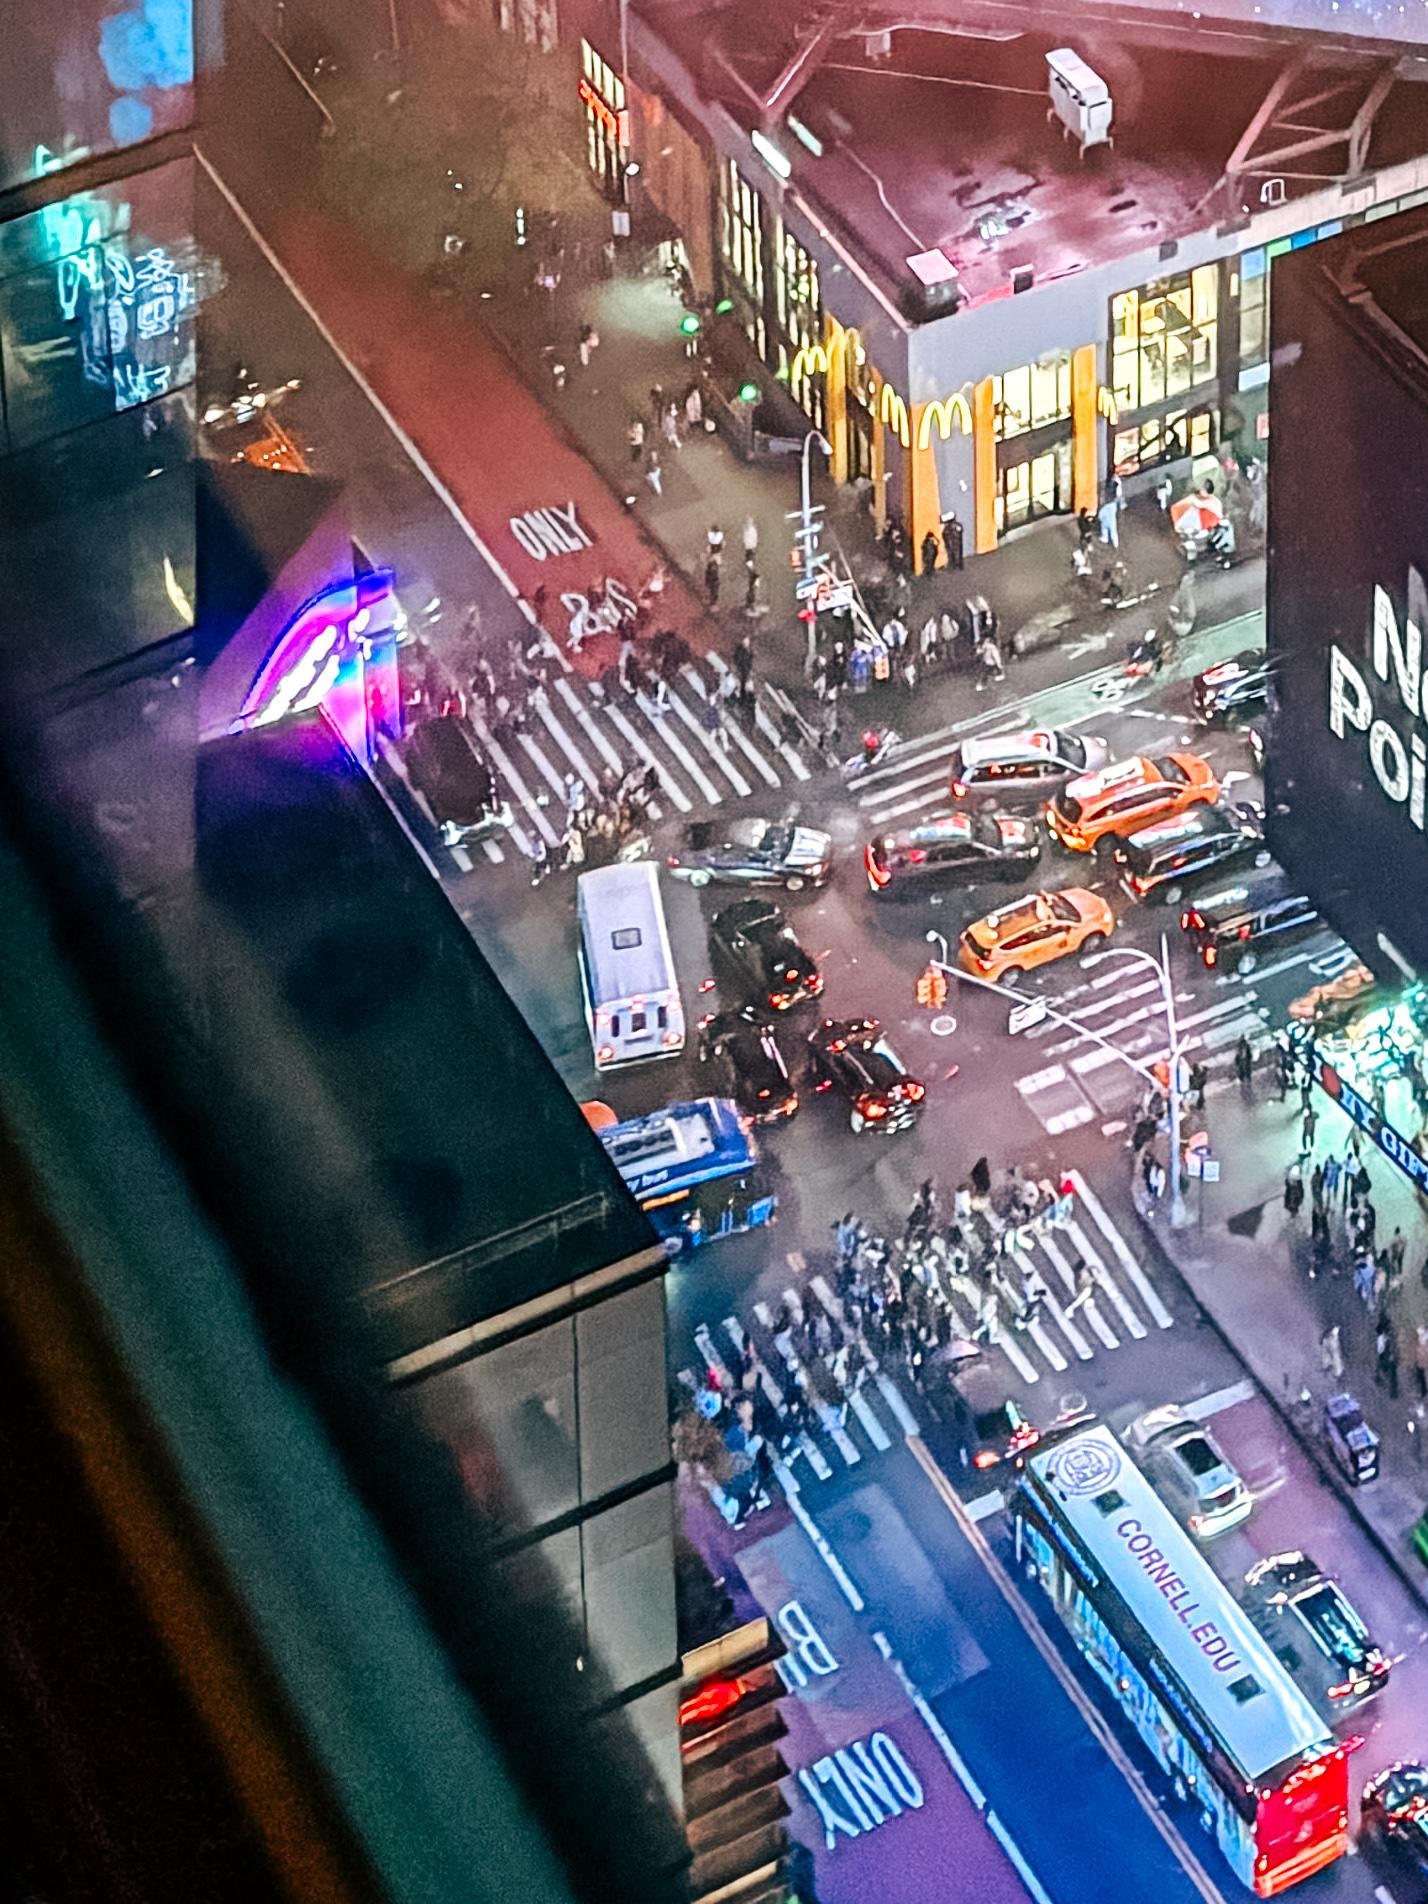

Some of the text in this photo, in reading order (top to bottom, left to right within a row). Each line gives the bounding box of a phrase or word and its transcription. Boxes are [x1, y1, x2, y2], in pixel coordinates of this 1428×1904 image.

[509, 499, 594, 562] ONLY
[1116, 1517, 1241, 1674] CORNELL.EDU
[799, 1731, 925, 1851] ONLY
